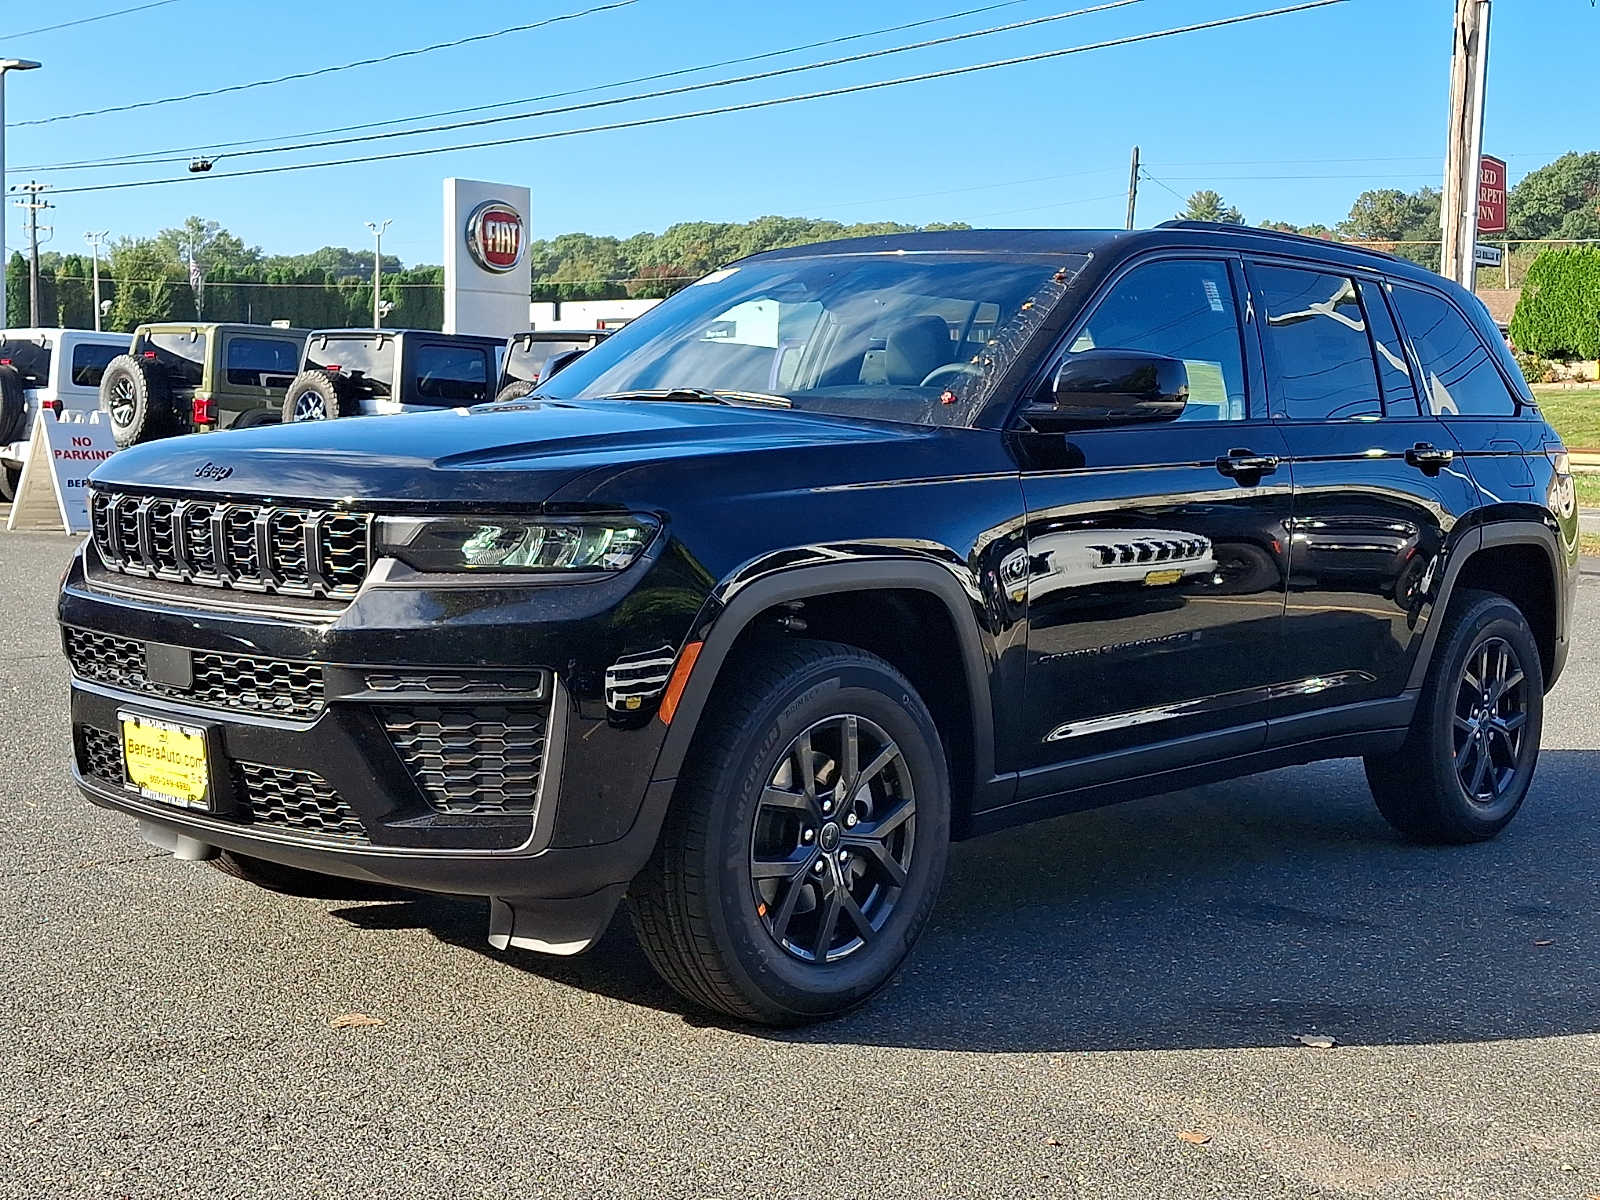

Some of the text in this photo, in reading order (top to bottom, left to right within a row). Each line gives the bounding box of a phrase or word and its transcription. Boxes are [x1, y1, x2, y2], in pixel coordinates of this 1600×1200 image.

[1480, 169, 1496, 185] RED
[486, 221, 517, 254] FIAT
[72, 437, 92, 447] NO
[194, 461, 234, 482] Jeep
